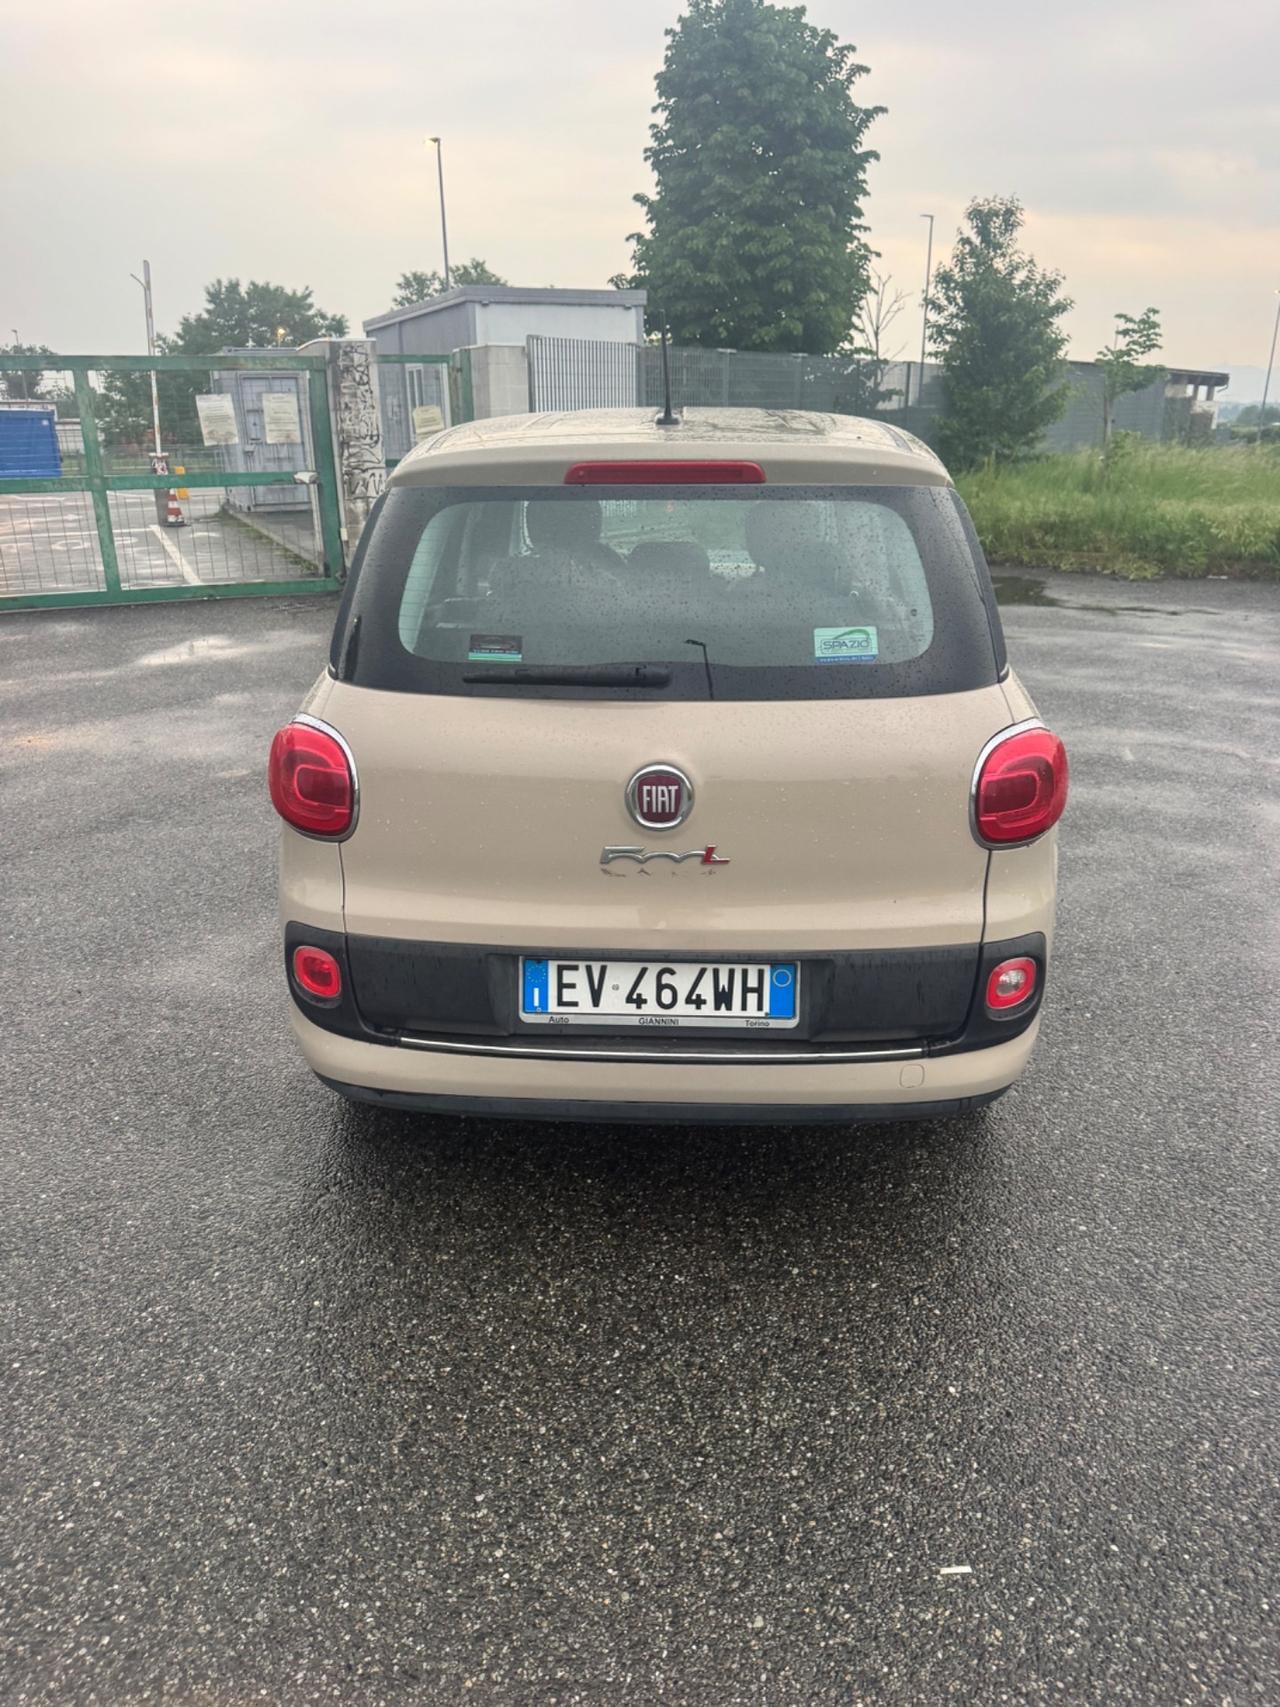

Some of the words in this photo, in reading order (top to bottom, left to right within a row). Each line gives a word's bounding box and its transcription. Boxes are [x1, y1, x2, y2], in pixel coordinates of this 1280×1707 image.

[822, 640, 870, 650] SPAZIO
[642, 785, 679, 814] FIAT
[556, 964, 608, 1008] EV
[624, 966, 766, 1012] 464WH
[549, 1016, 569, 1024] Auto
[638, 1017, 680, 1026] GIANNINI
